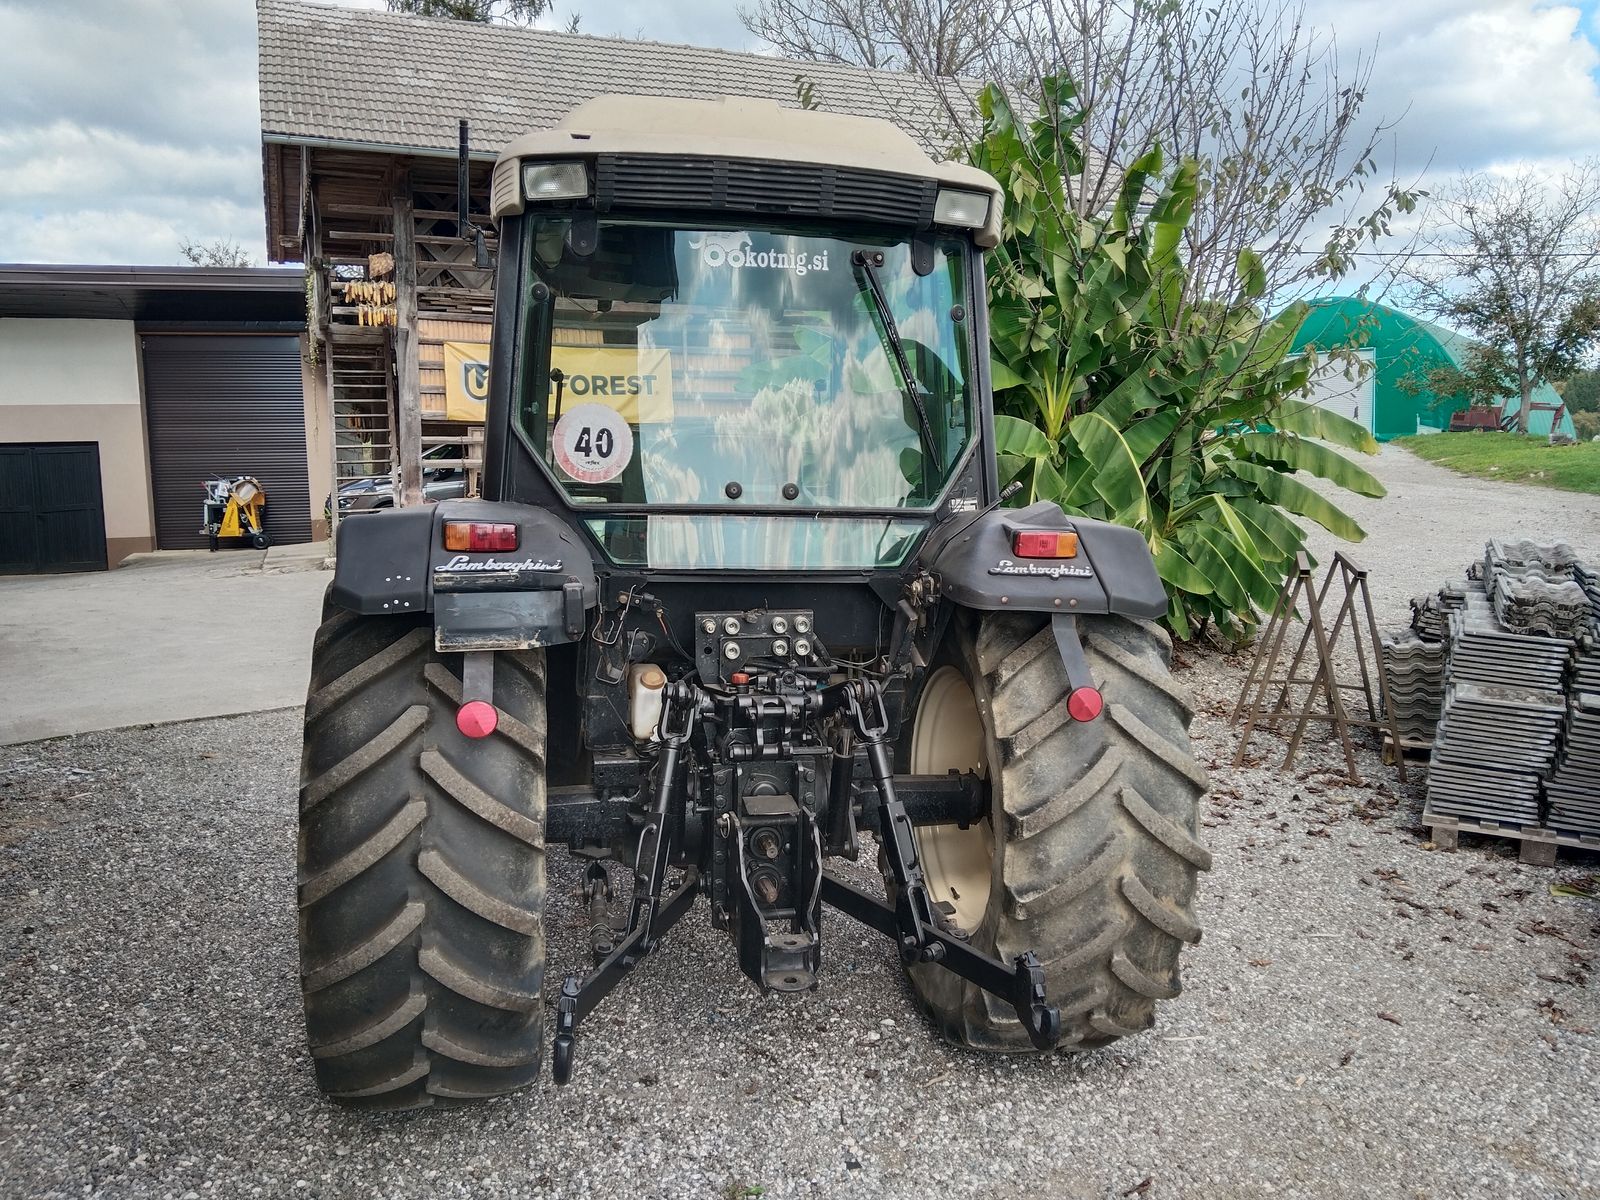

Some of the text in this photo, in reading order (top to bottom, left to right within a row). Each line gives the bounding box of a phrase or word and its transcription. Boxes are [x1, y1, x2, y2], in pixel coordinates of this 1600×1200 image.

[745, 245, 829, 275] kotnig.si
[549, 374, 657, 396] FOREST
[574, 427, 614, 458] 40
[434, 555, 563, 572] Lamborghini
[988, 559, 1093, 580] Lamborghini
